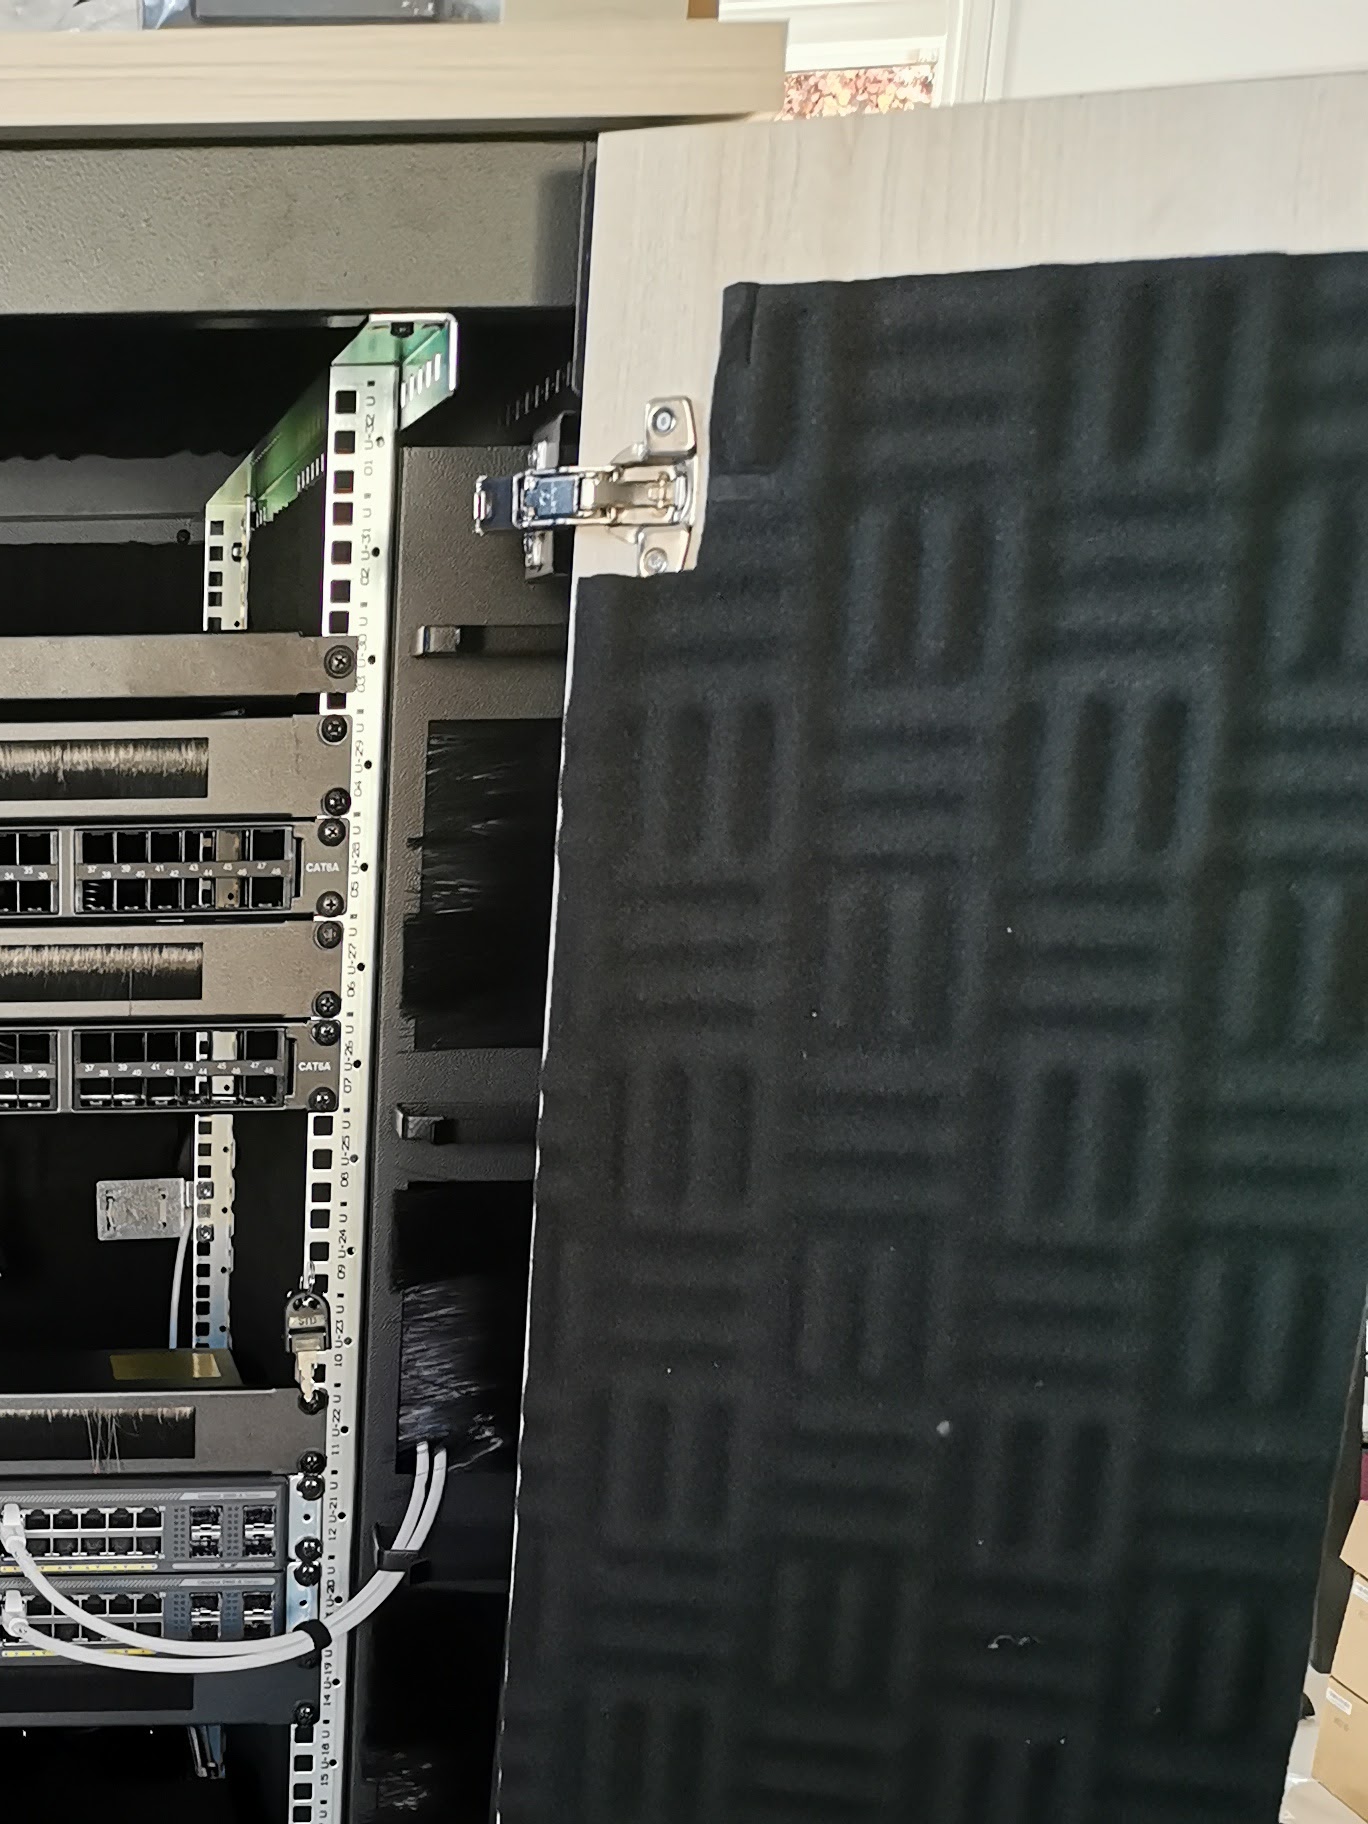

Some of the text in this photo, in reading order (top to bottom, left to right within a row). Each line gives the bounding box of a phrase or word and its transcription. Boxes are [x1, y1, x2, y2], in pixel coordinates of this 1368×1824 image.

[305, 862, 340, 873] CAT6A
[298, 1061, 332, 1072] CAT6A
[342, 1077, 353, 1093] 07
[336, 1263, 346, 1280] 09
[333, 1353, 343, 1367] 10
[327, 1528, 338, 1541] 12
